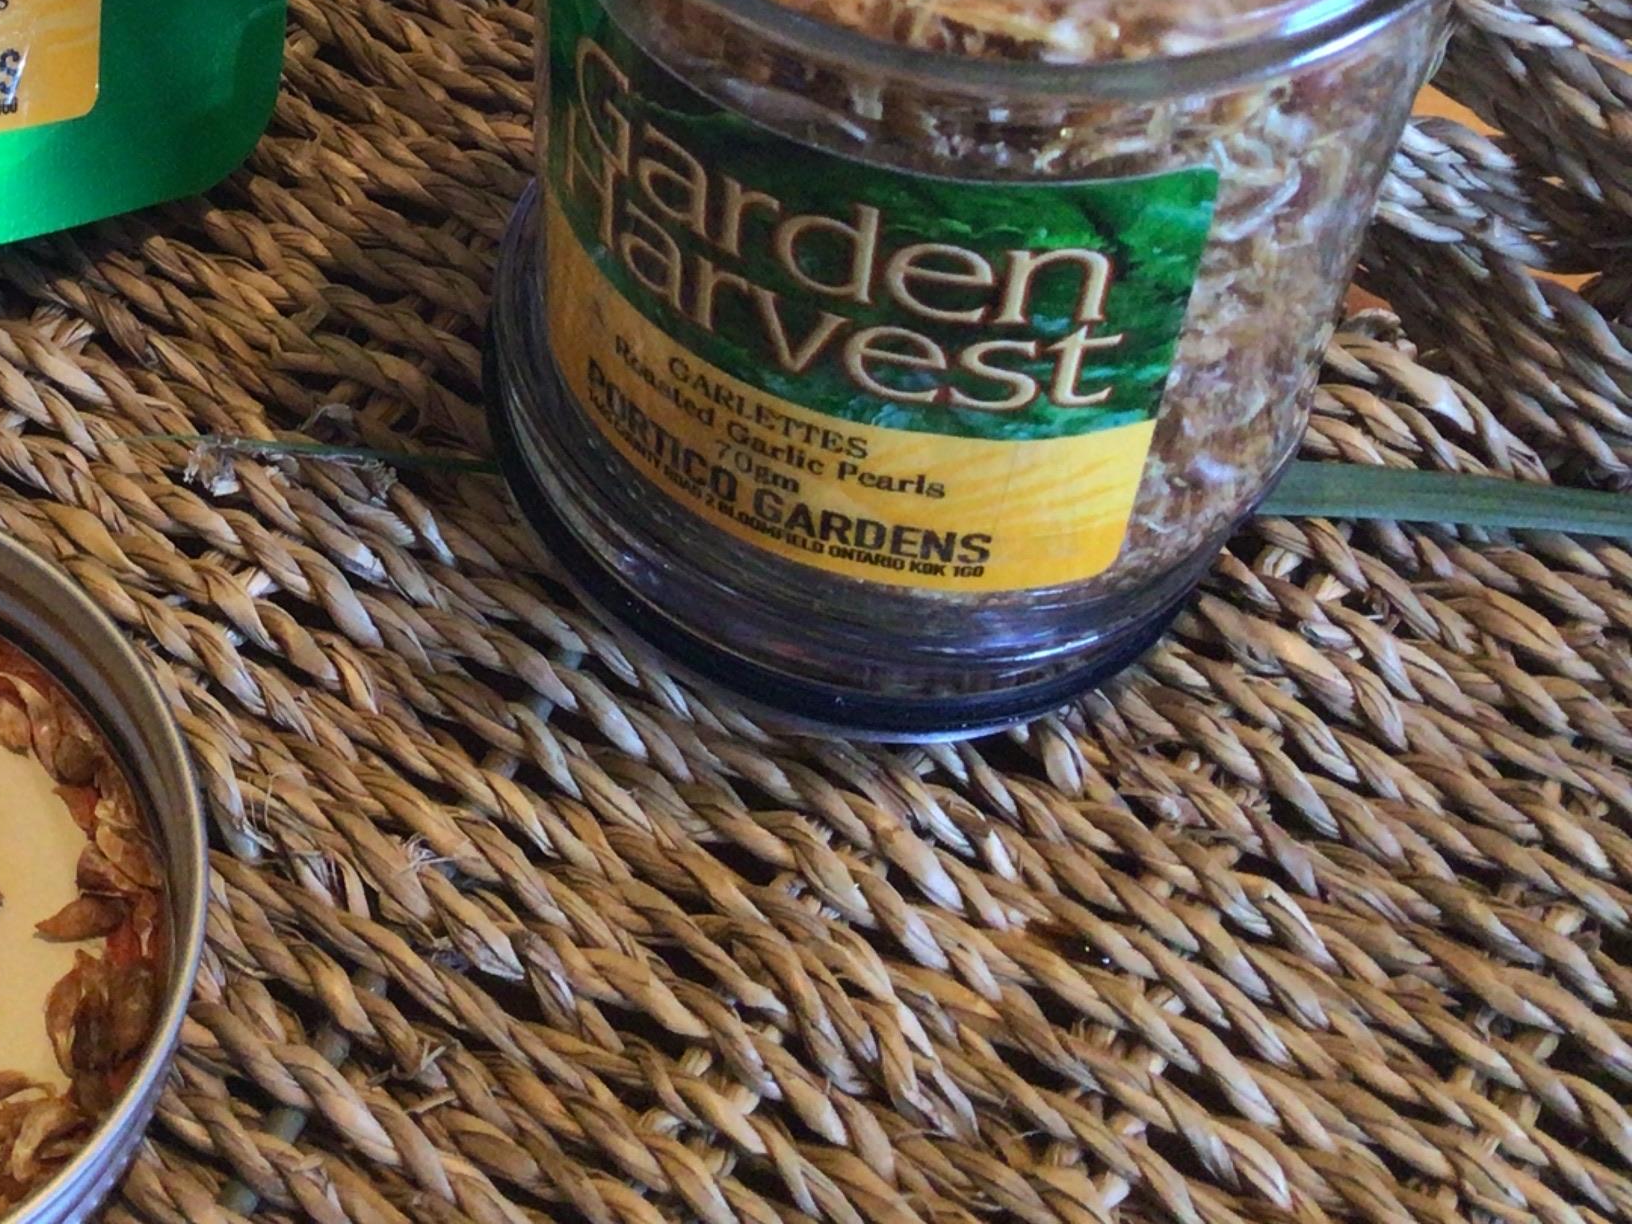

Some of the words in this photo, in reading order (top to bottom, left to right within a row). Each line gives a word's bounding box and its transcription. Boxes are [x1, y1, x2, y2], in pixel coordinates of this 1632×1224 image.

[575, 37, 1112, 326] Garden
[565, 99, 1125, 412] Harvest
[669, 356, 868, 459] GARLETTES
[727, 419, 824, 475] Garlic
[837, 460, 946, 499] Pearls
[588, 355, 738, 503] PORTICO
[753, 487, 993, 564] GARDENS
[715, 439, 800, 493] 70gm
[828, 544, 905, 571] ONTARIO
